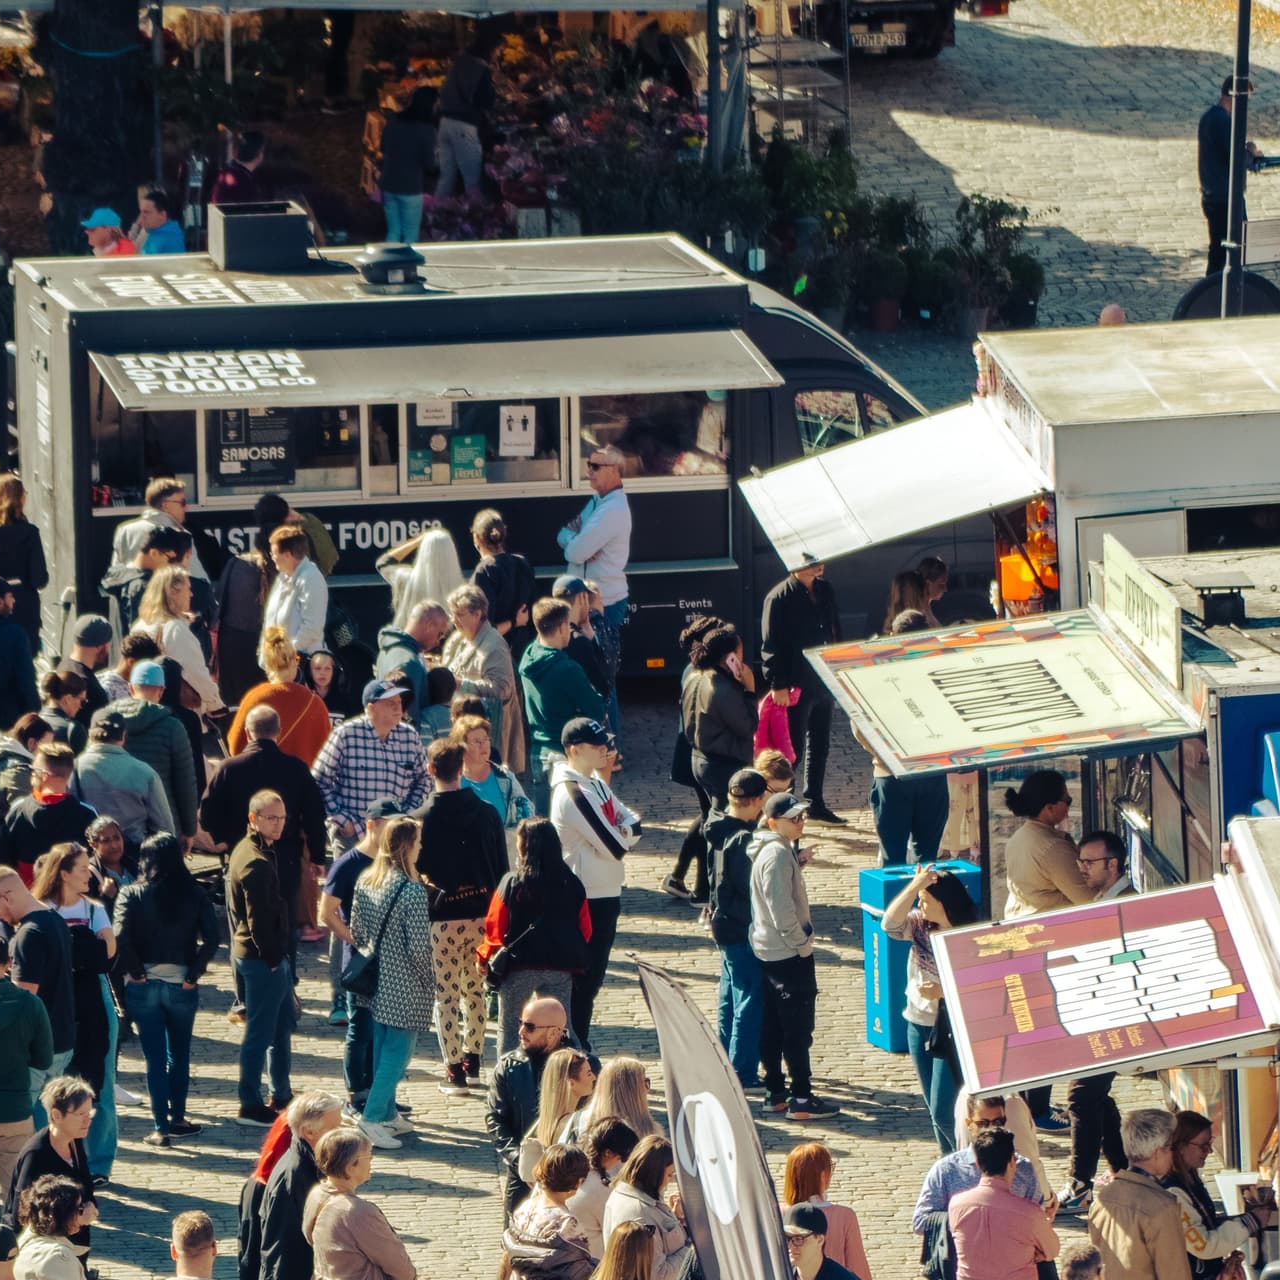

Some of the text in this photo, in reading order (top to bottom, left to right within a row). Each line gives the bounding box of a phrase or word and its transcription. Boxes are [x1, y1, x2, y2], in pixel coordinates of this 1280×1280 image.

[116, 351, 304, 370] INDIAN
[124, 364, 305, 382] STREET
[222, 446, 286, 461] SAMOSAS
[679, 598, 713, 609] Events
[928, 658, 1086, 733] JEFFREY'S
